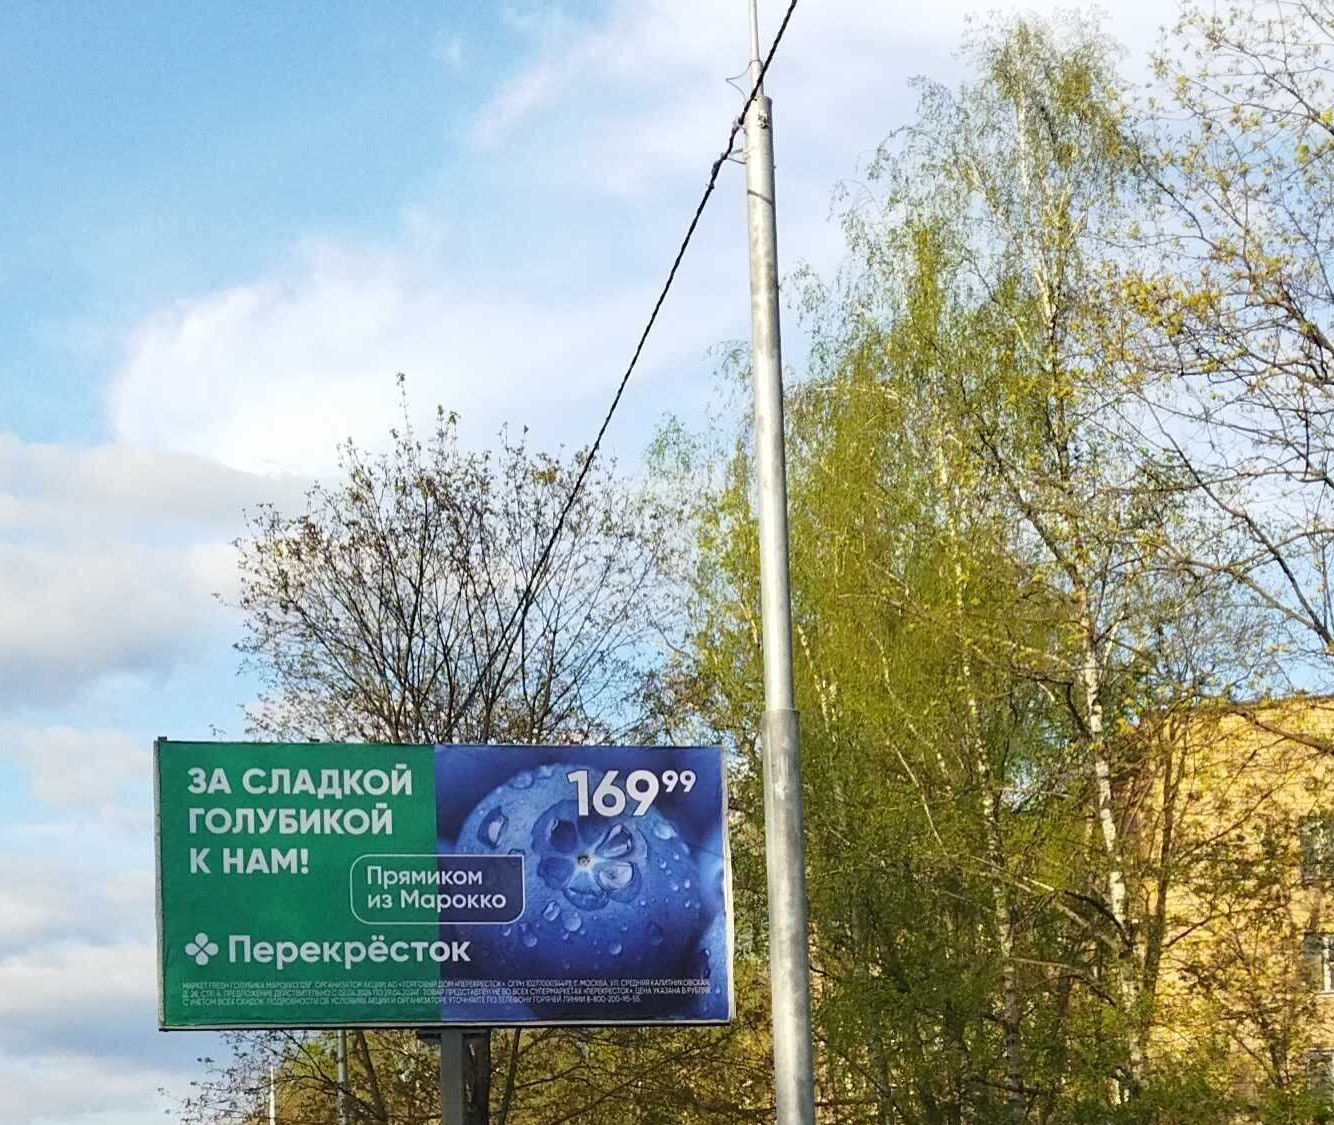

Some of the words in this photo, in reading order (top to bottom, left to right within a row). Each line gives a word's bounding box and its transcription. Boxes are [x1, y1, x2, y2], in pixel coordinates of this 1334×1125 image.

[188, 767, 231, 794] ЗА
[242, 763, 413, 799] СЛАДКОЙ
[189, 802, 393, 835] ГОЛУБИКОЙ
[190, 848, 211, 874] К
[223, 848, 309, 874] НАМ!
[367, 866, 483, 889] Прямиком
[367, 895, 393, 909] из
[401, 890, 507, 913] Марокко
[228, 934, 471, 969] Перекрёсток
